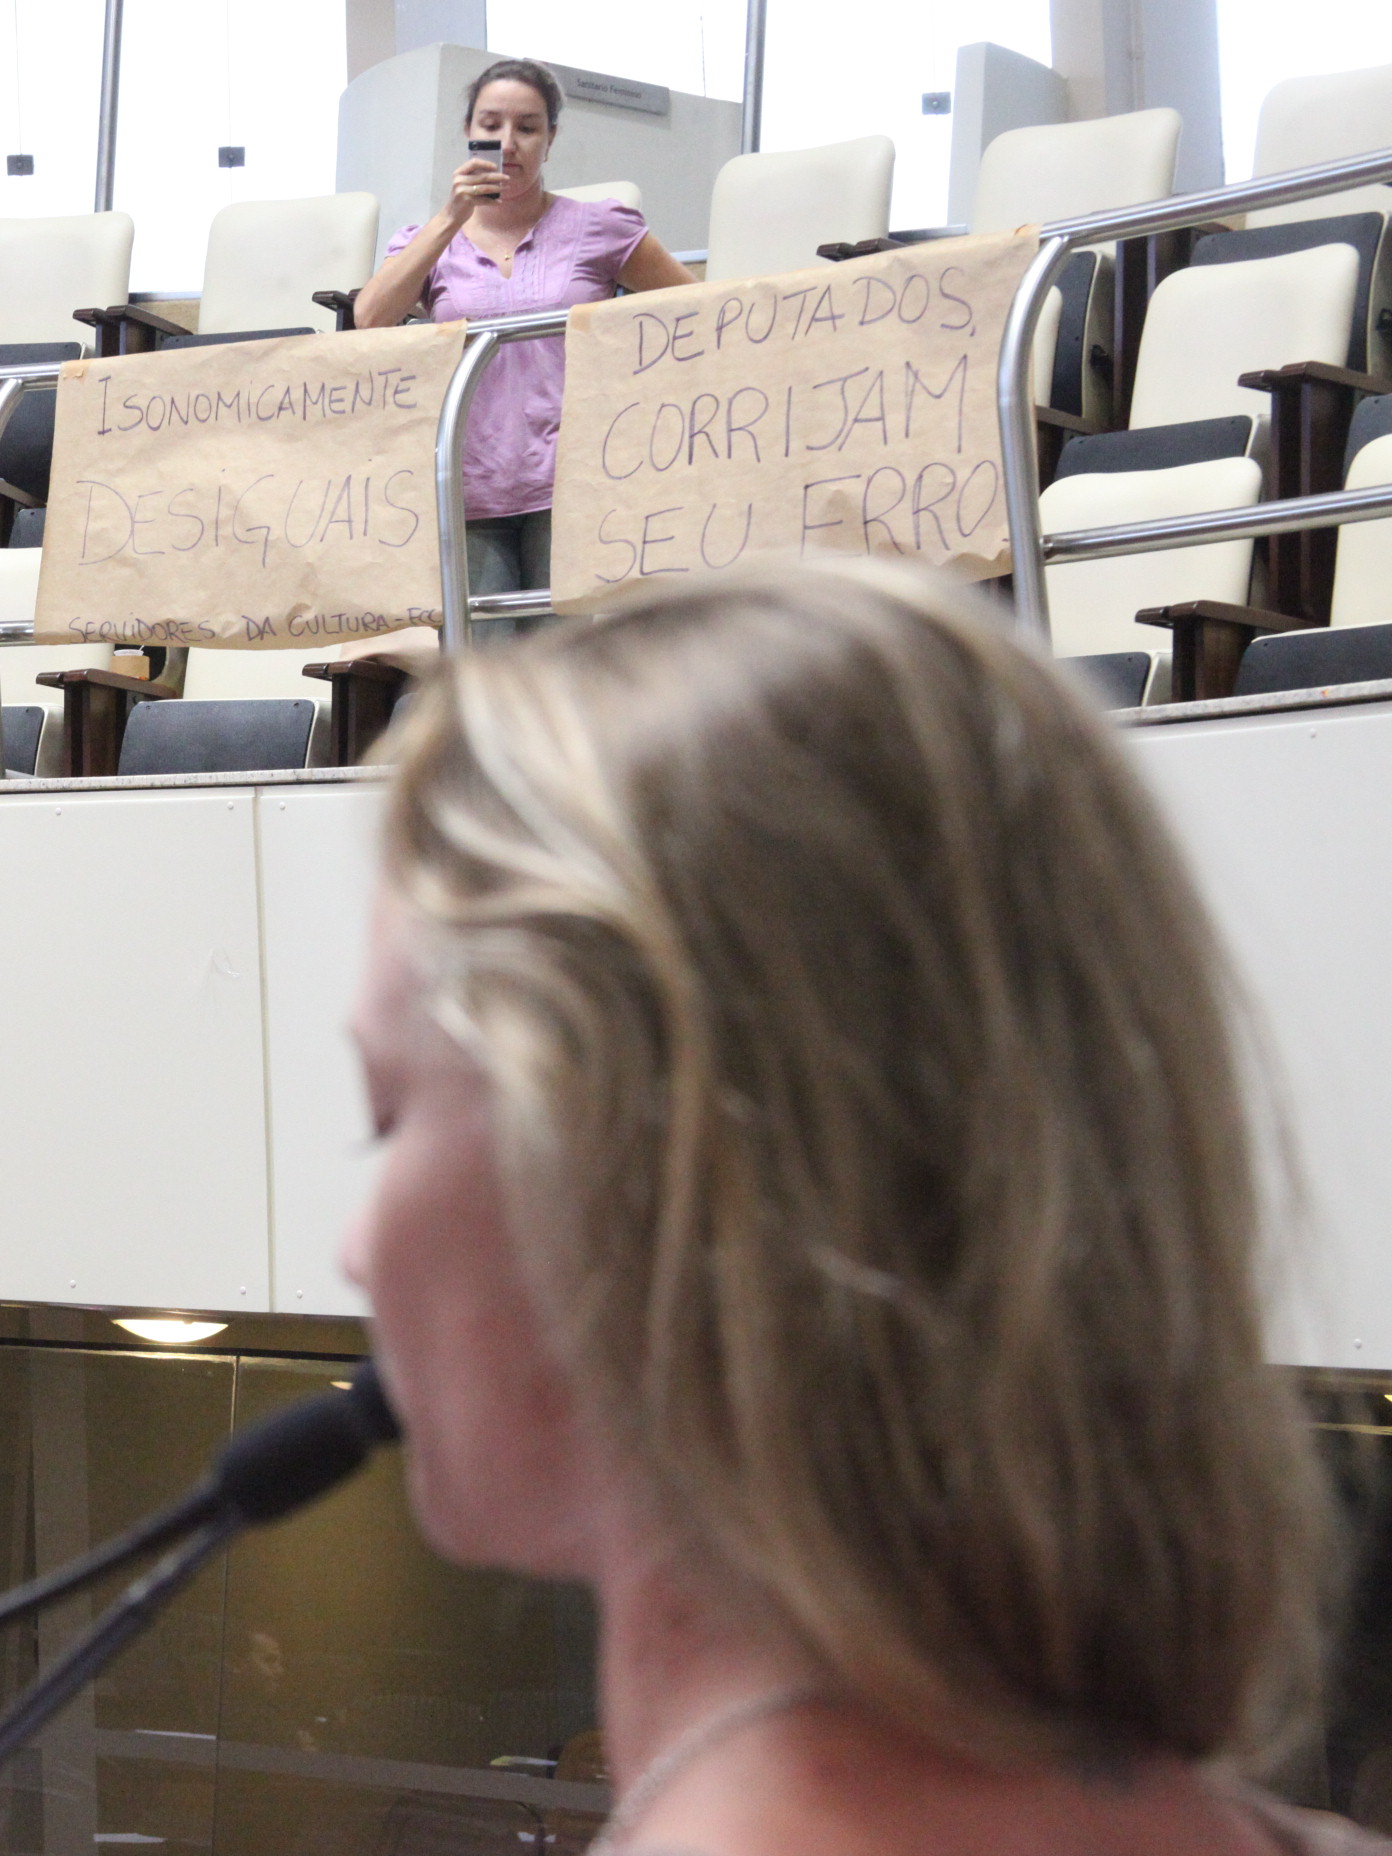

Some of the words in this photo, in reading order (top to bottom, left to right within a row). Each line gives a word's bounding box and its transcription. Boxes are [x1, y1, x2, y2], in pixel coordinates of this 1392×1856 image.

[632, 266, 977, 376] DEPUTADOS,
[96, 367, 418, 436] ISONOMICAMENTE
[601, 352, 969, 481] CORRIJAM
[75, 460, 420, 569] DESIGUAIS
[594, 502, 753, 584] SEU
[68, 611, 217, 644] SERVIDORES
[241, 614, 278, 642] DA
